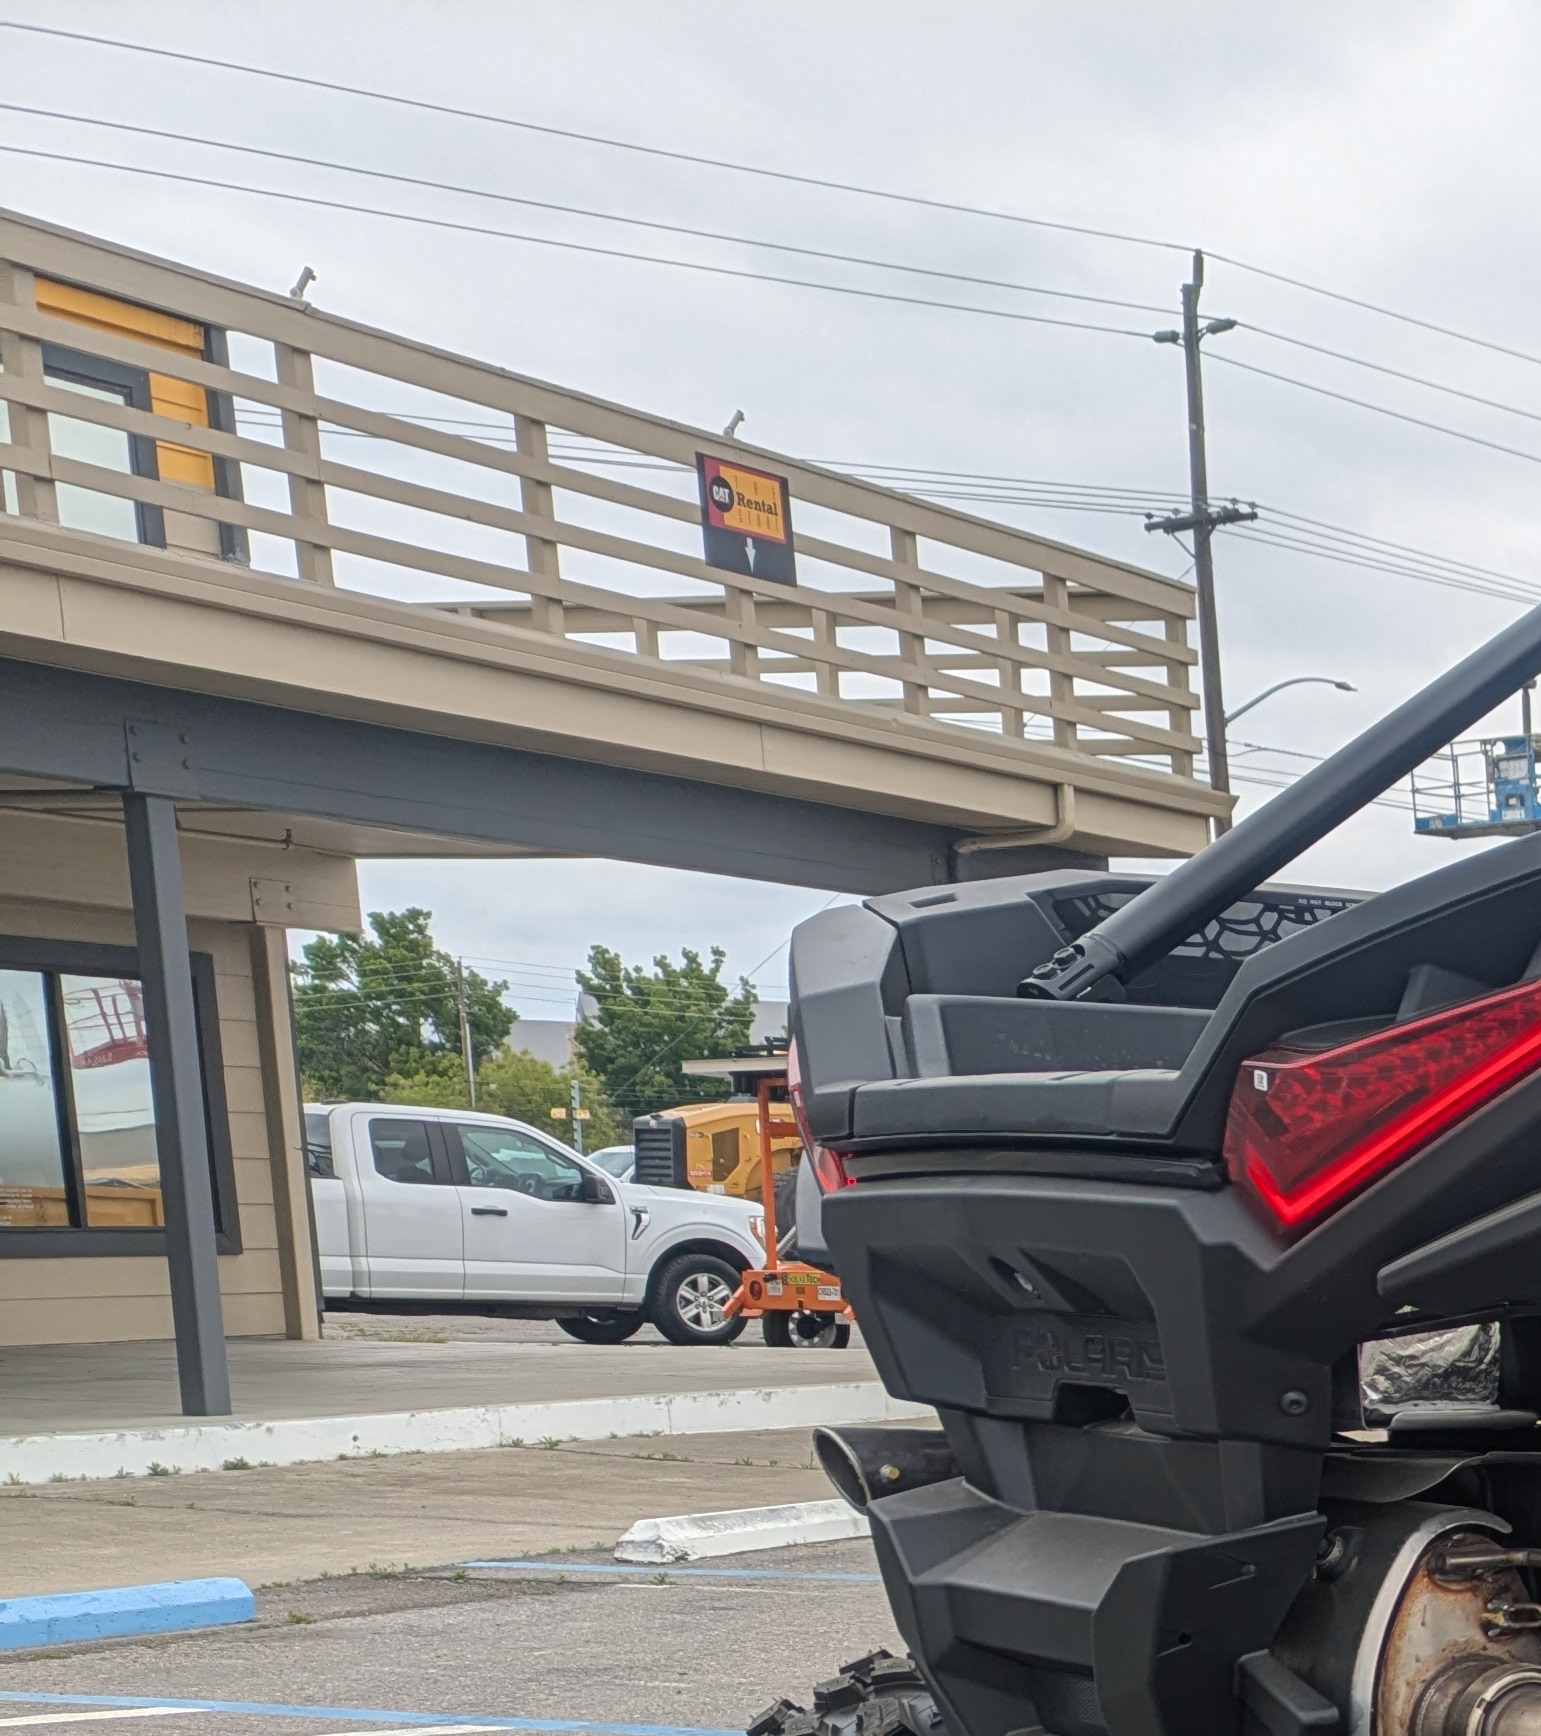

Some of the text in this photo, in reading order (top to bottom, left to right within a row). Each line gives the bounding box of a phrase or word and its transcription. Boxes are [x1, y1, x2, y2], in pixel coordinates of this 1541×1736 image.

[712, 484, 730, 504] CAT
[735, 491, 779, 517] Rental
[1012, 1330, 1166, 1381] POLARIS
